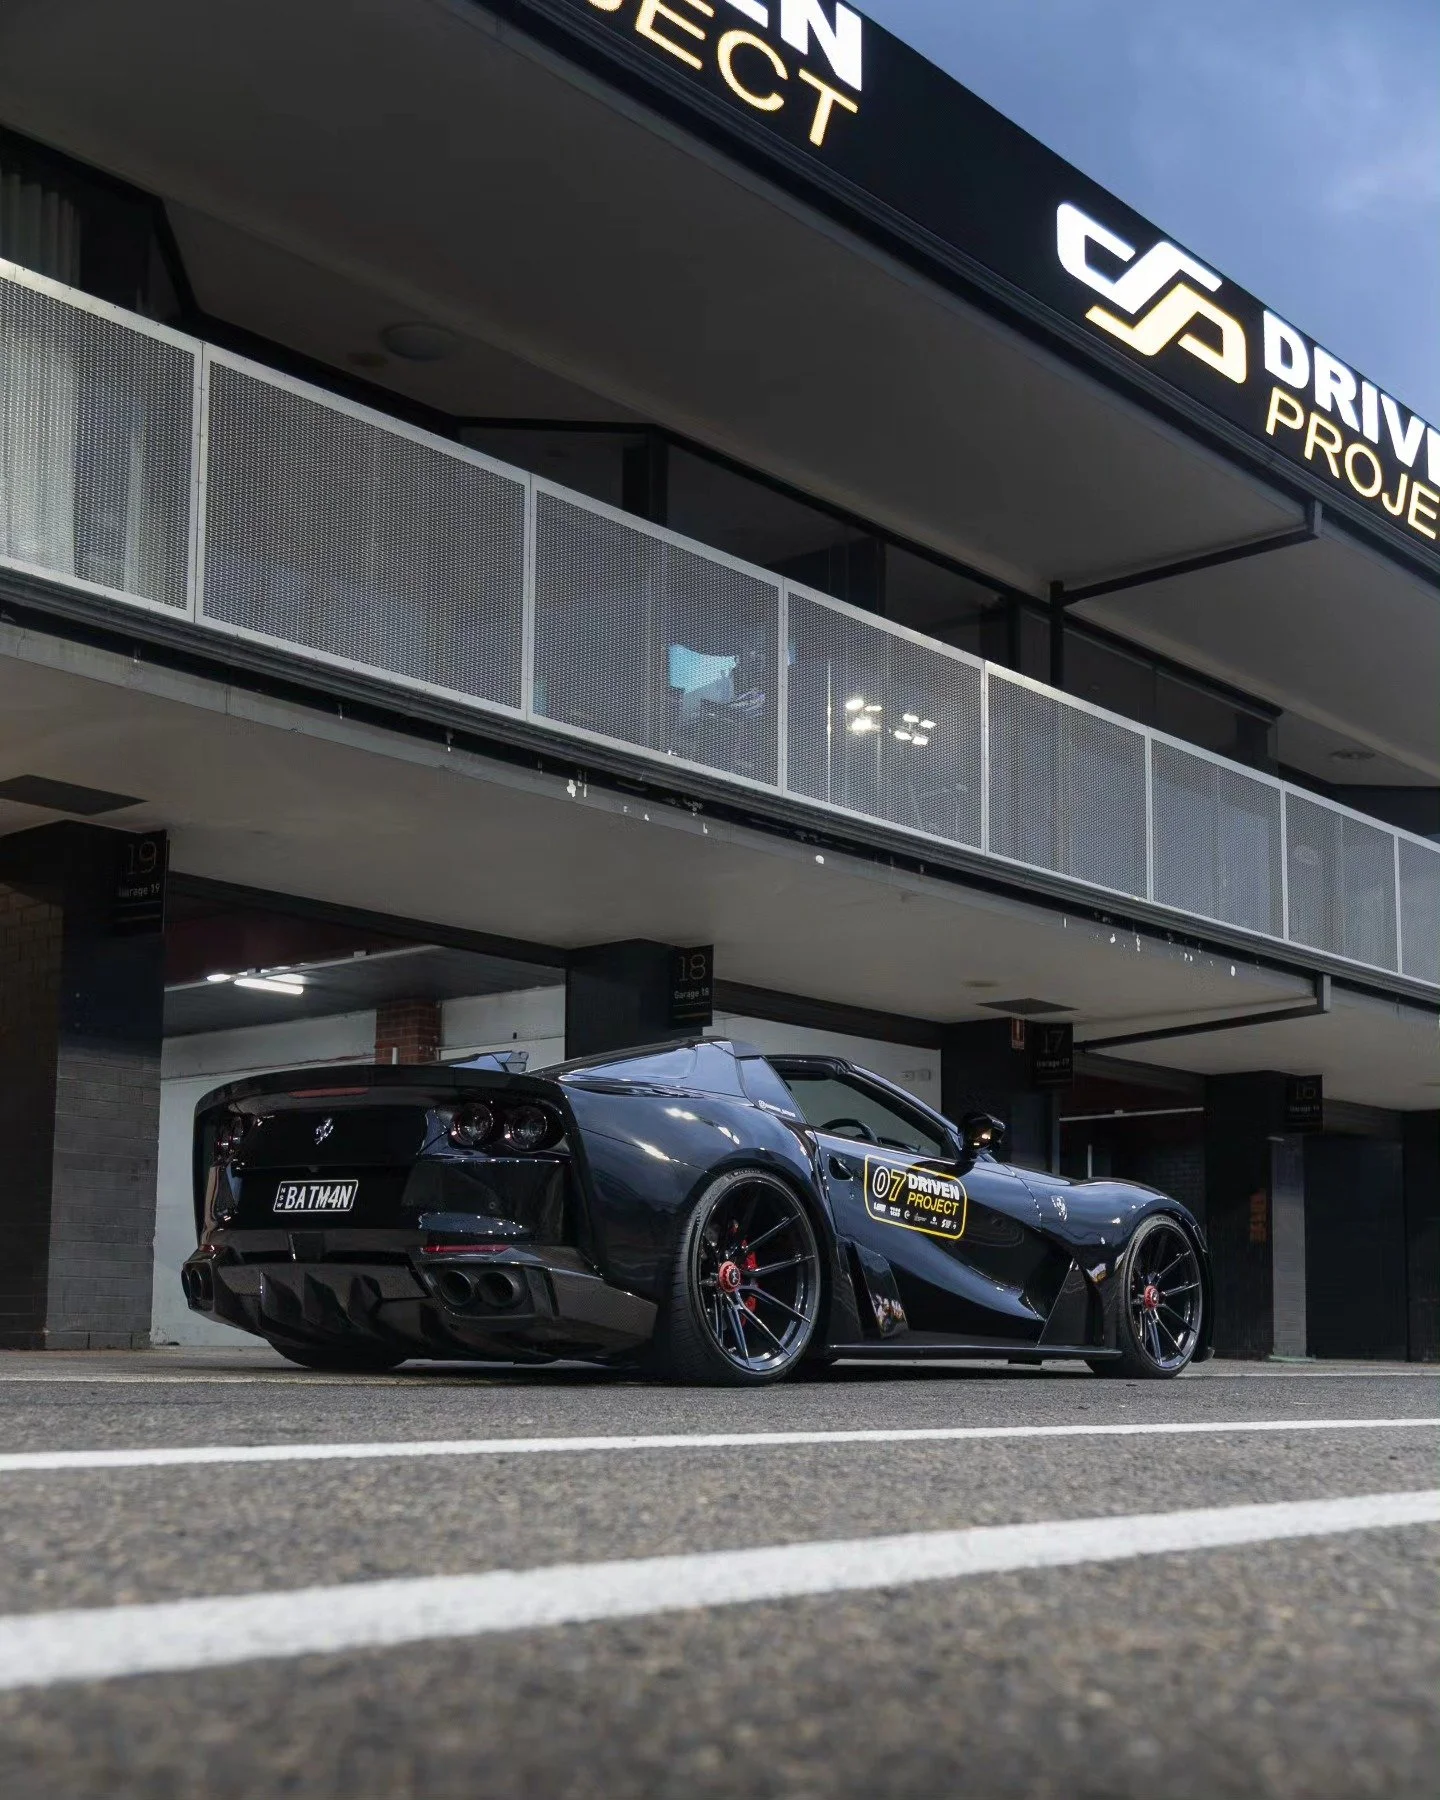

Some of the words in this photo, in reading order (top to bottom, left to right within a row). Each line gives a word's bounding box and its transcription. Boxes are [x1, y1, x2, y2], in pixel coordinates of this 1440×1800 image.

[725, 0, 862, 91] N
[588, 0, 858, 146] ECT
[1265, 386, 1440, 539] PROJE
[128, 841, 156, 875] 19
[679, 954, 706, 981] 18
[1041, 1030, 1064, 1054] 17
[285, 1185, 353, 1210] BATM4N
[873, 1166, 906, 1201] 07
[908, 1173, 960, 1200] DRIVEN
[907, 1192, 959, 1216] PROJECT
